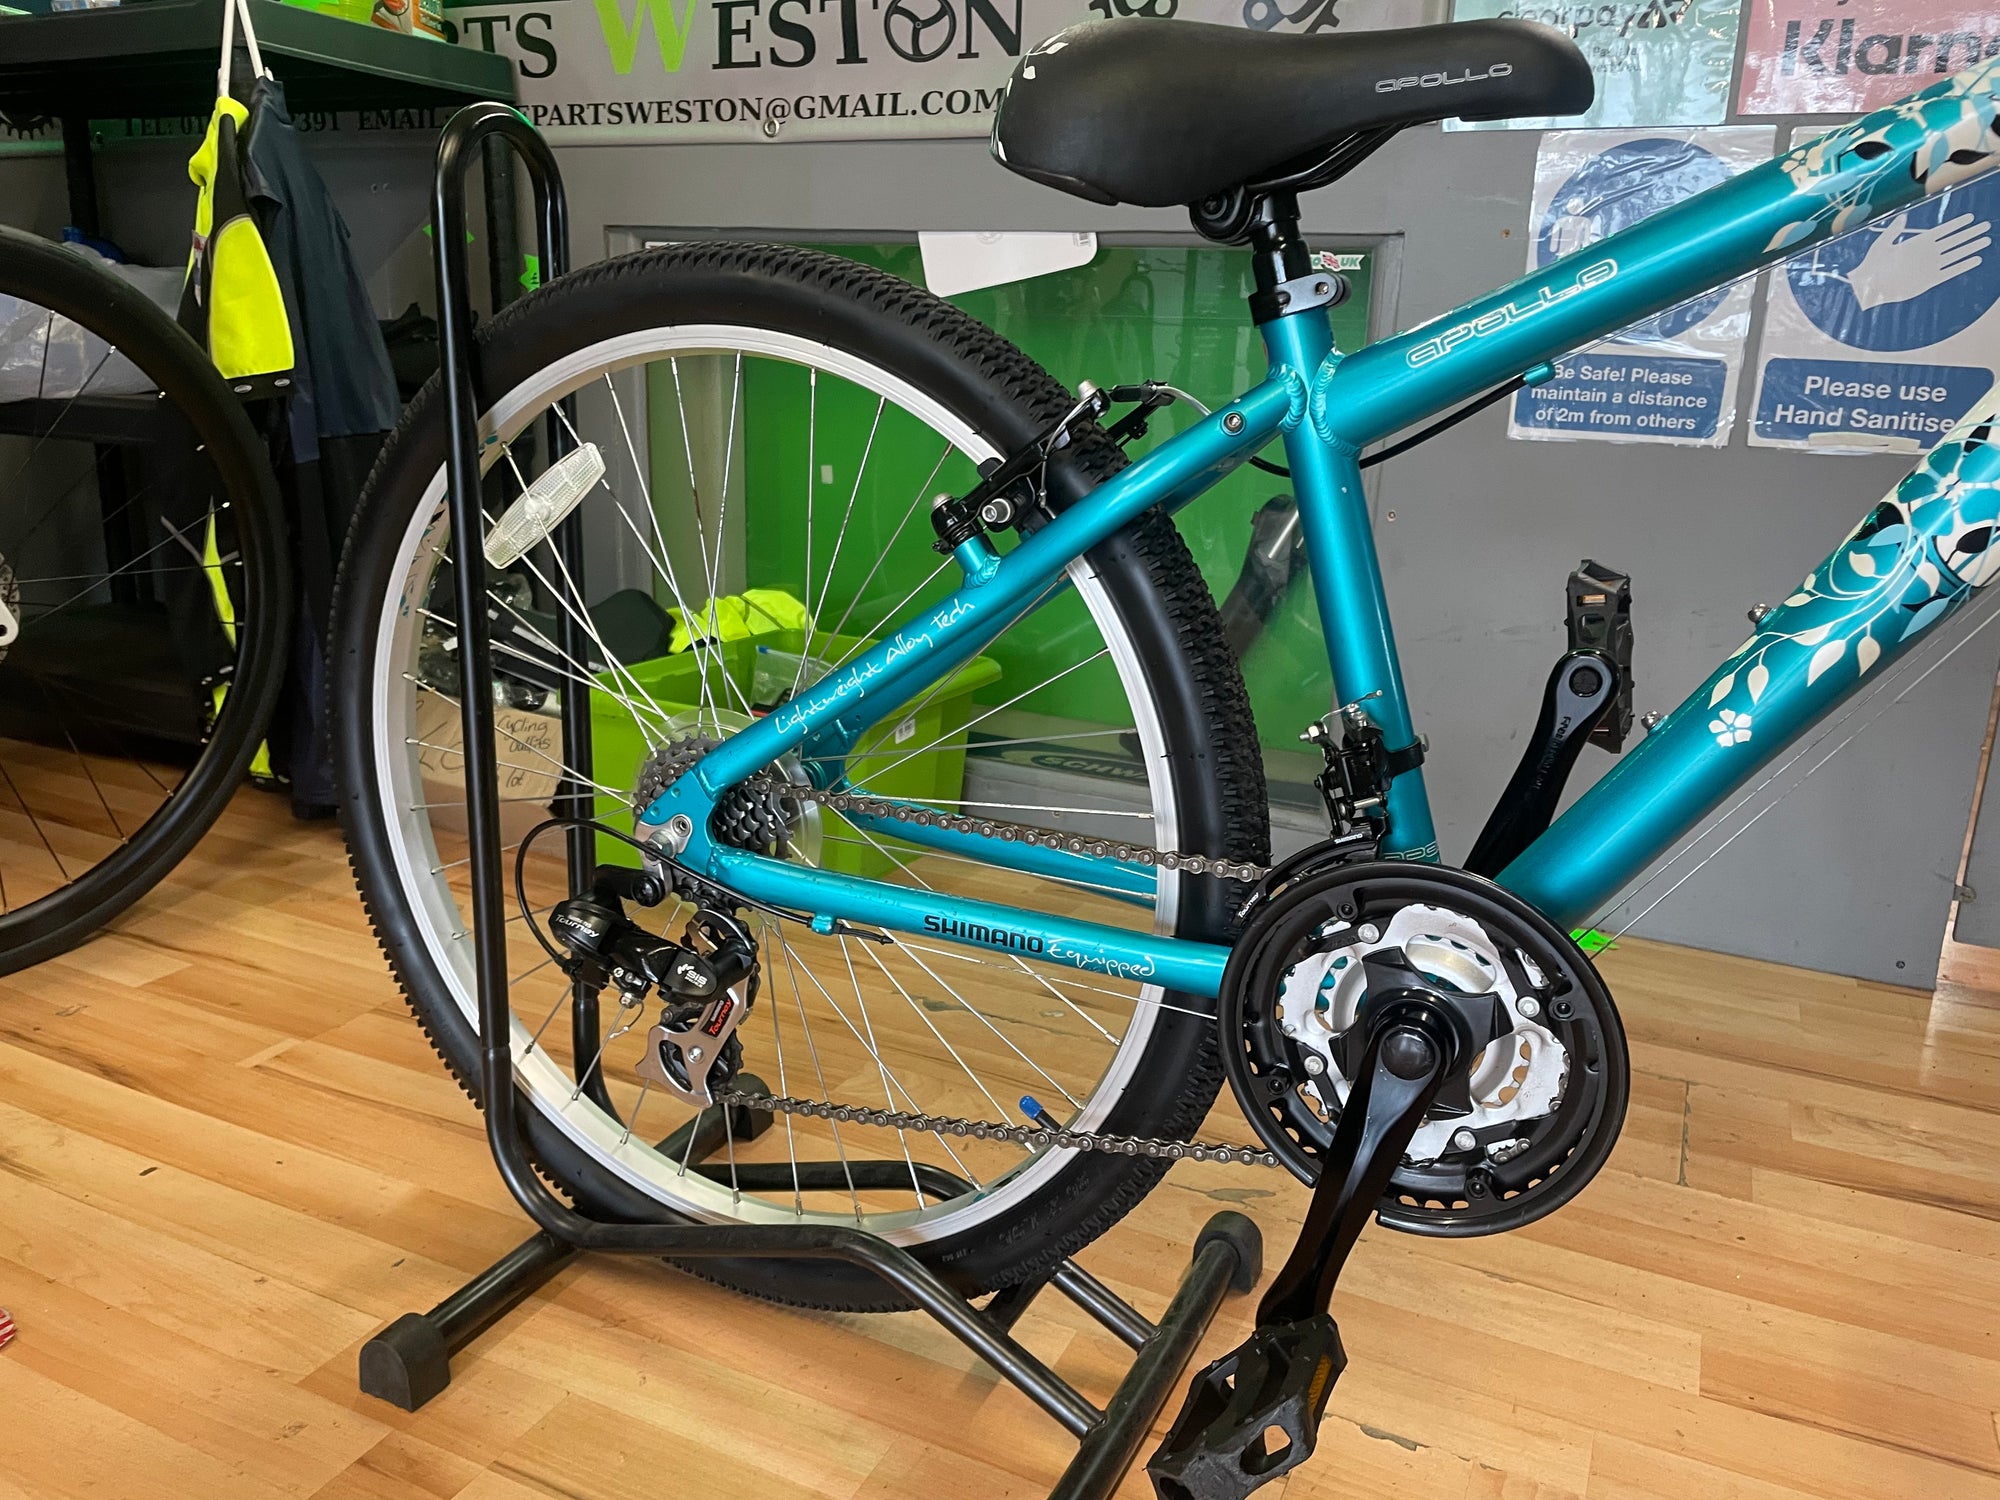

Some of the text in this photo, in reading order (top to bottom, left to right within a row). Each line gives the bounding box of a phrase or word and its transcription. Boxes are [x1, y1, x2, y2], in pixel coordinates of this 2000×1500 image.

[1580, 365, 1625, 382] Safe!
[1630, 368, 1694, 385] Please
[1804, 375, 1948, 402] Please use
[1531, 386, 1708, 409] maintain a distance
[1535, 407, 1697, 430] of 2m from others
[1774, 403, 1957, 433] Hand Sanitise
[775, 662, 884, 735] Lightweight
[886, 632, 934, 665] Alloy
[930, 597, 975, 631] Tech
[1043, 757, 1148, 779] SCHW
[923, 914, 1156, 979] SHIMANO Equipped
[708, 997, 732, 1036] Tourney
